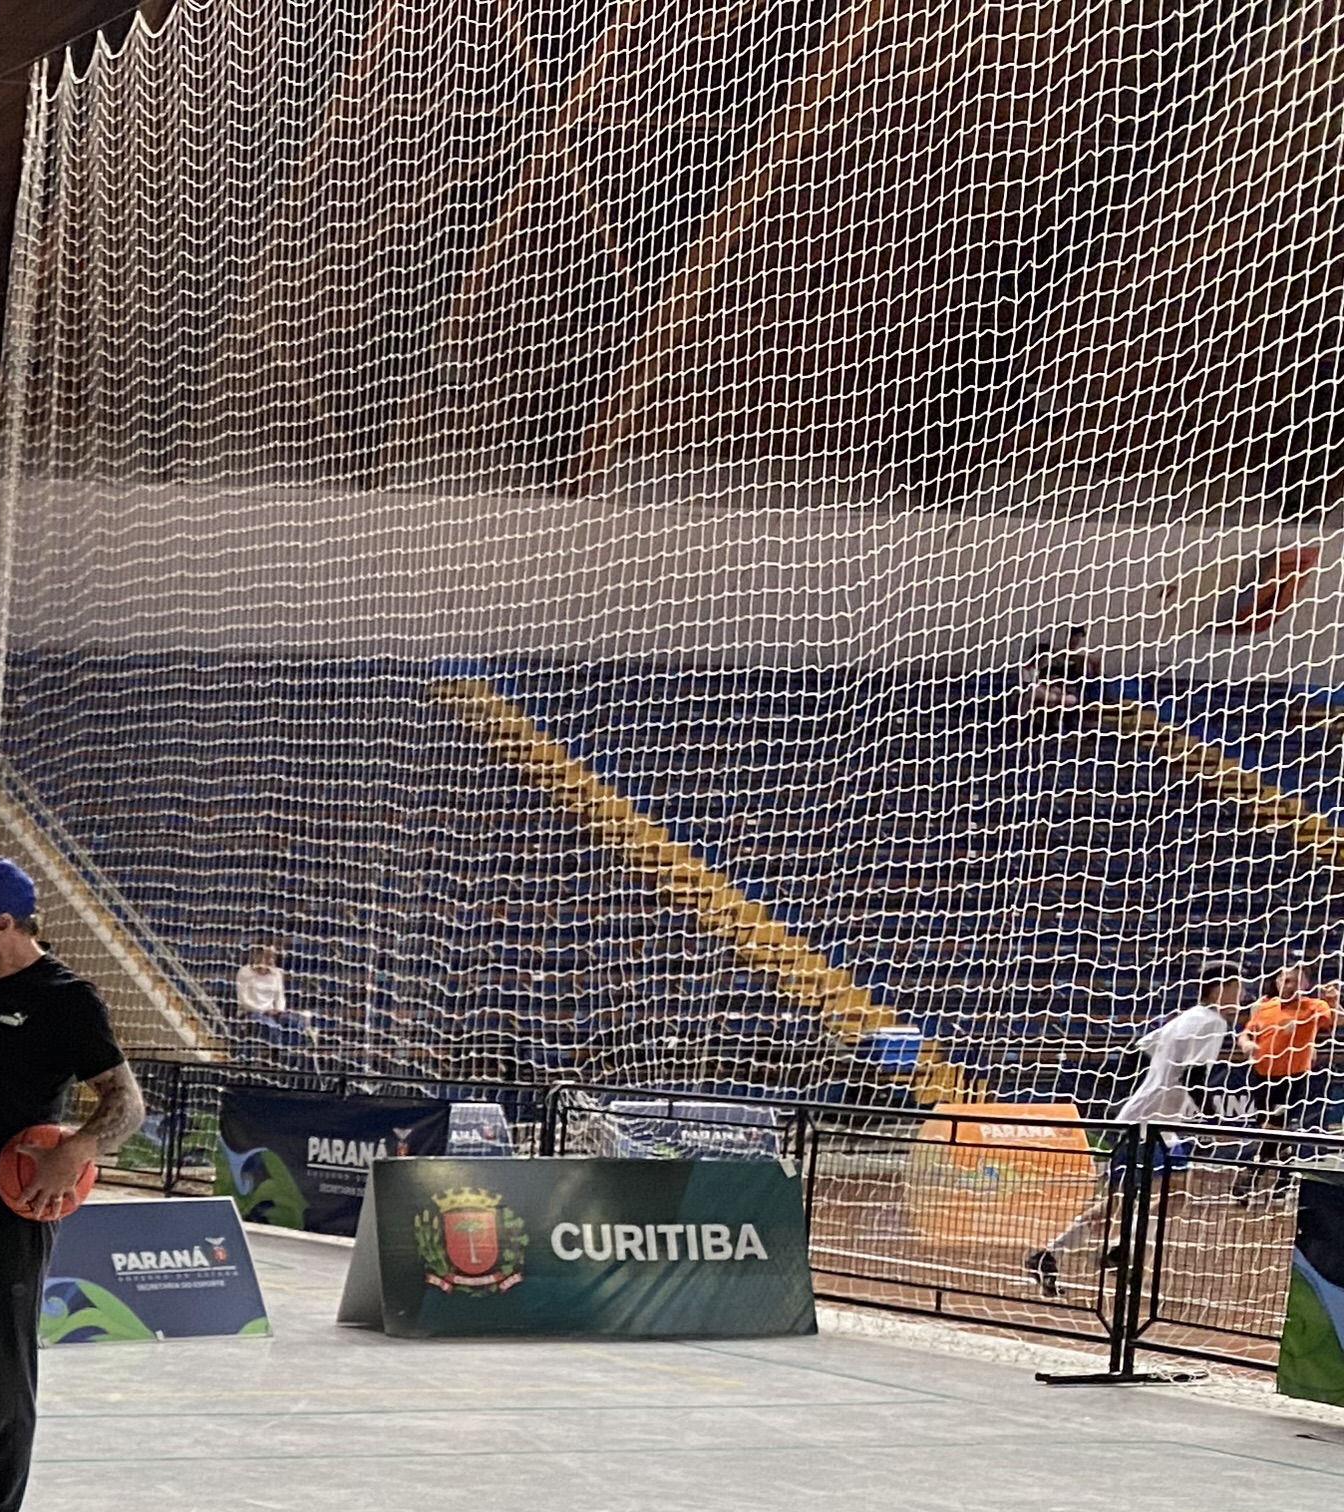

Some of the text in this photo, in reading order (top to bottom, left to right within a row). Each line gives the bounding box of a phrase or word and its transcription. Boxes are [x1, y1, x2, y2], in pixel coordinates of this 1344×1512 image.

[308, 1136, 388, 1166] PARANÁ
[551, 1222, 768, 1261] CURITIBA
[112, 1246, 210, 1271] PARANÁ
